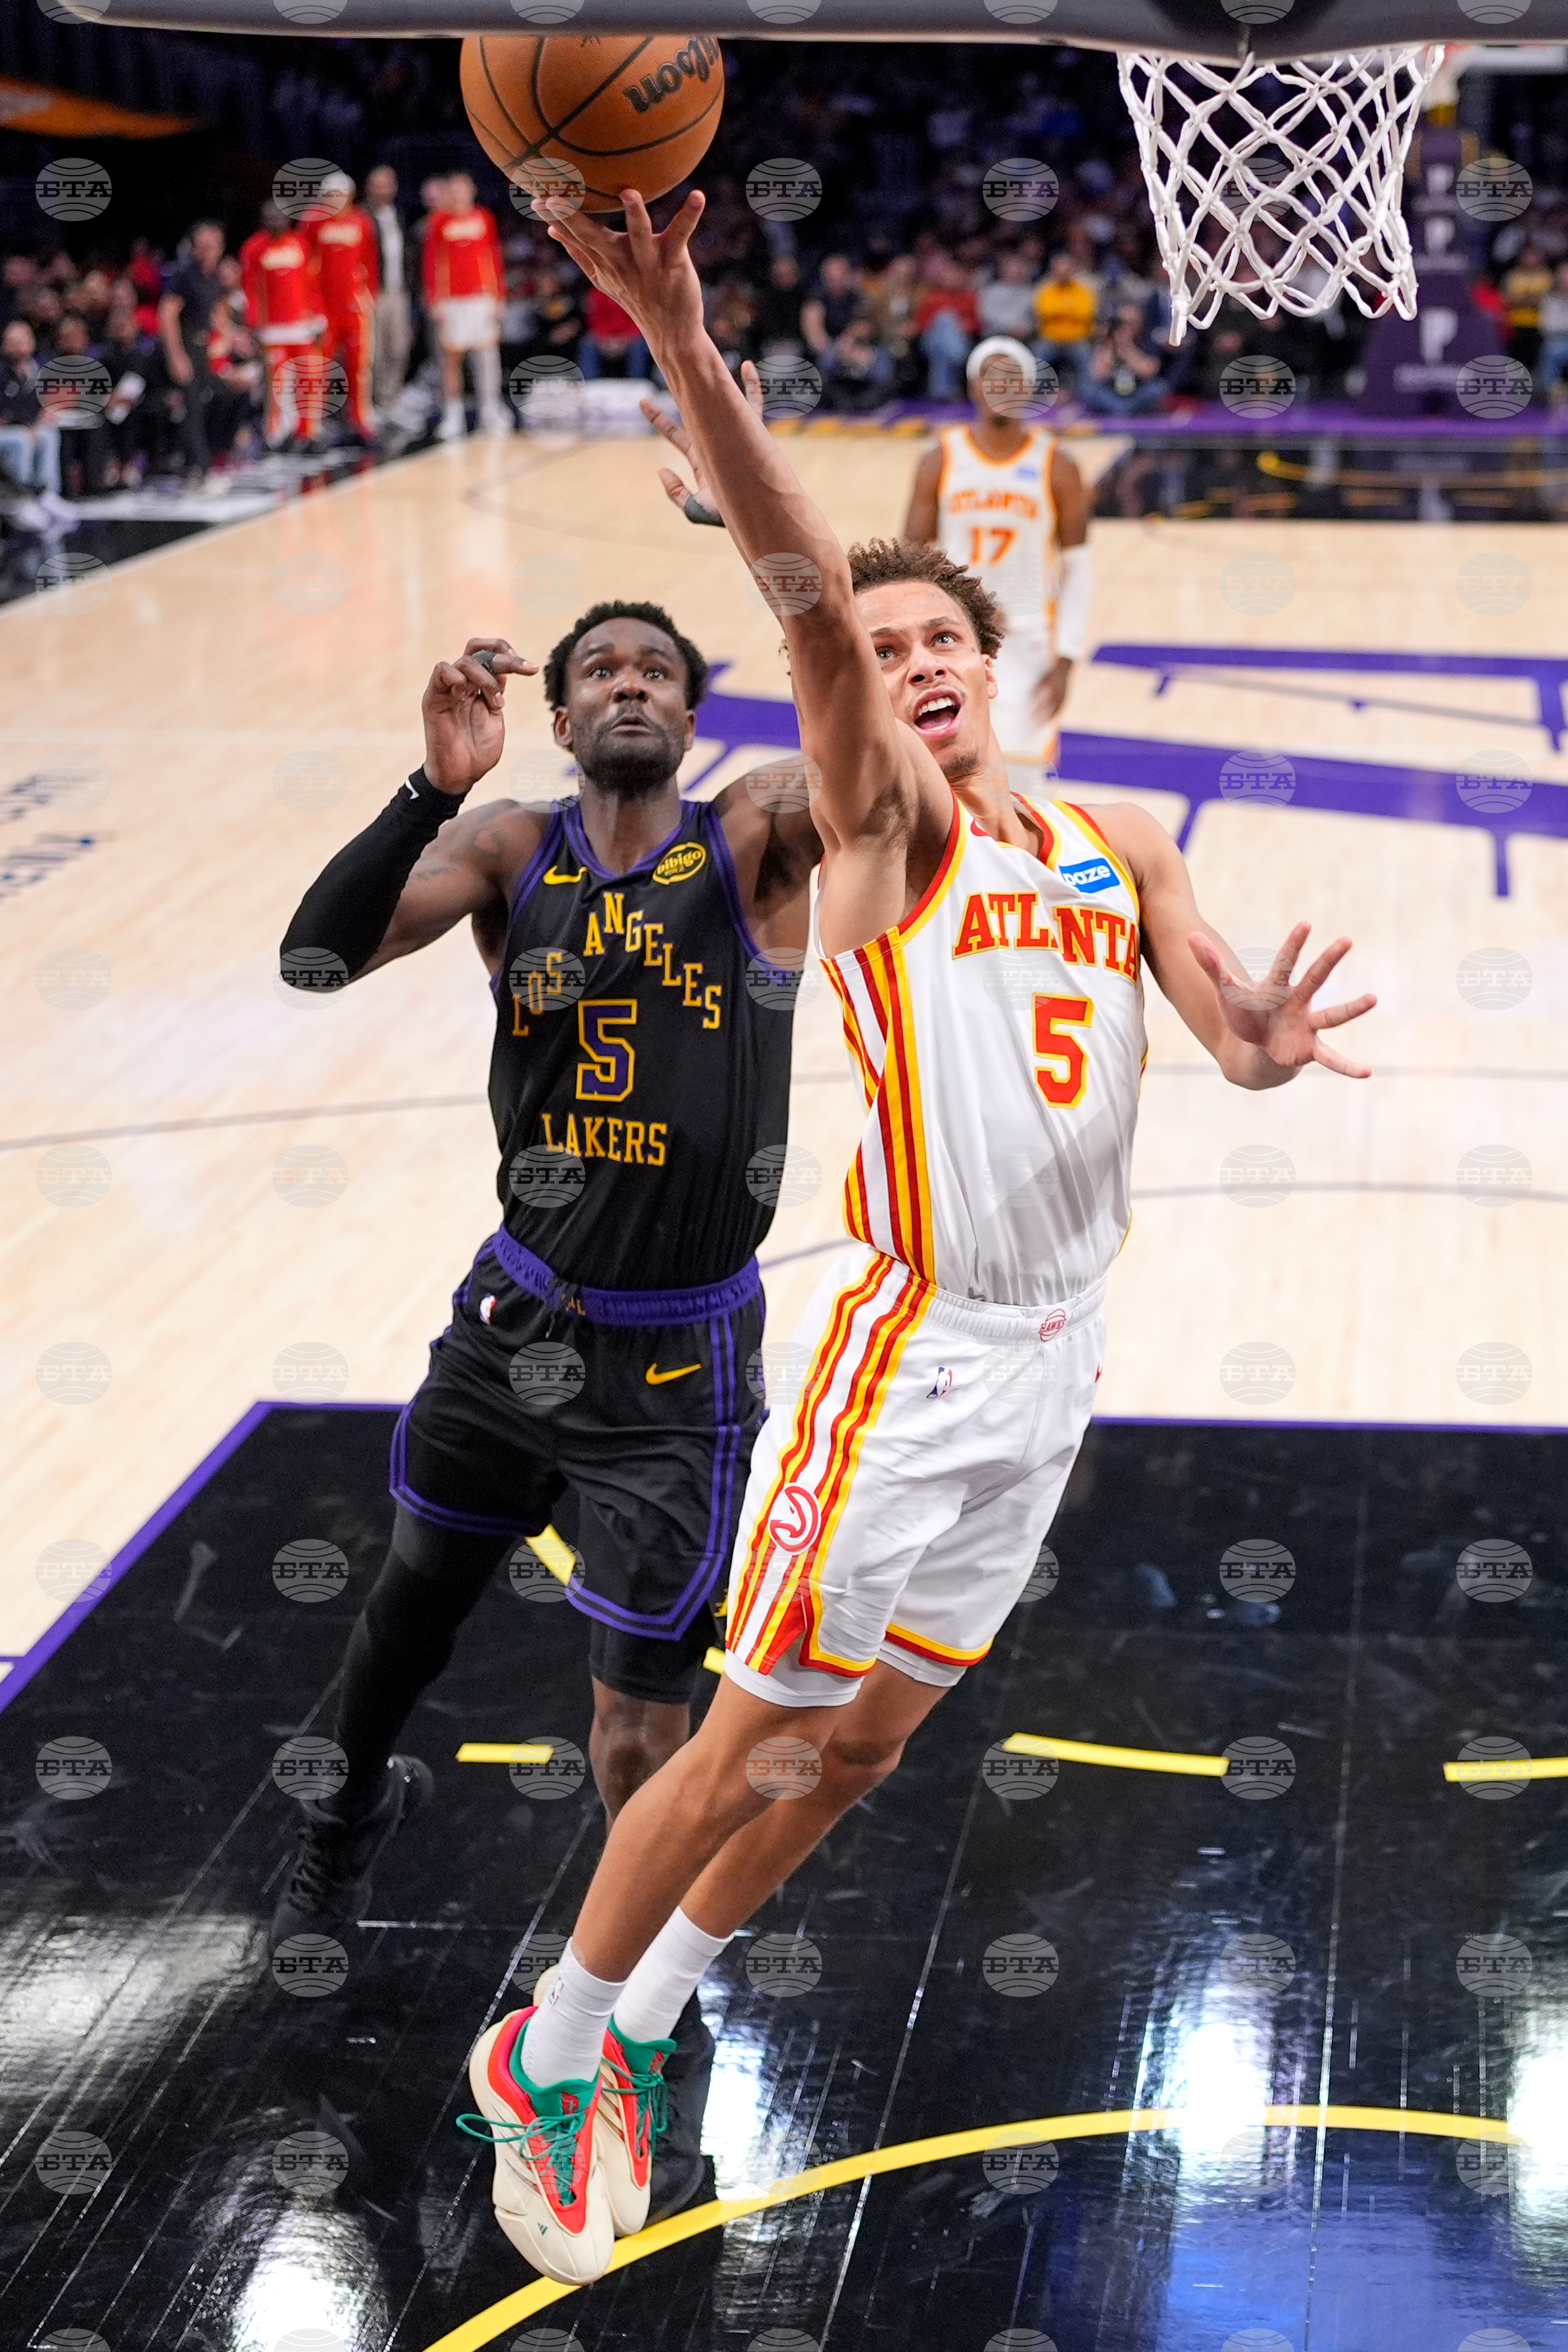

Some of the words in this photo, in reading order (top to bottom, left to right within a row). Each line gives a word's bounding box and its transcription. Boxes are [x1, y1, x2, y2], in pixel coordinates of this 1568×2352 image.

[971, 527, 1014, 564] 17
[512, 952, 562, 1037] LOS
[583, 891, 723, 1029] ANGELES
[952, 890, 1139, 985] ATLNTA
[575, 998, 637, 1102] 5
[1033, 992, 1096, 1110] 5
[541, 1112, 668, 1167] LAKERS
